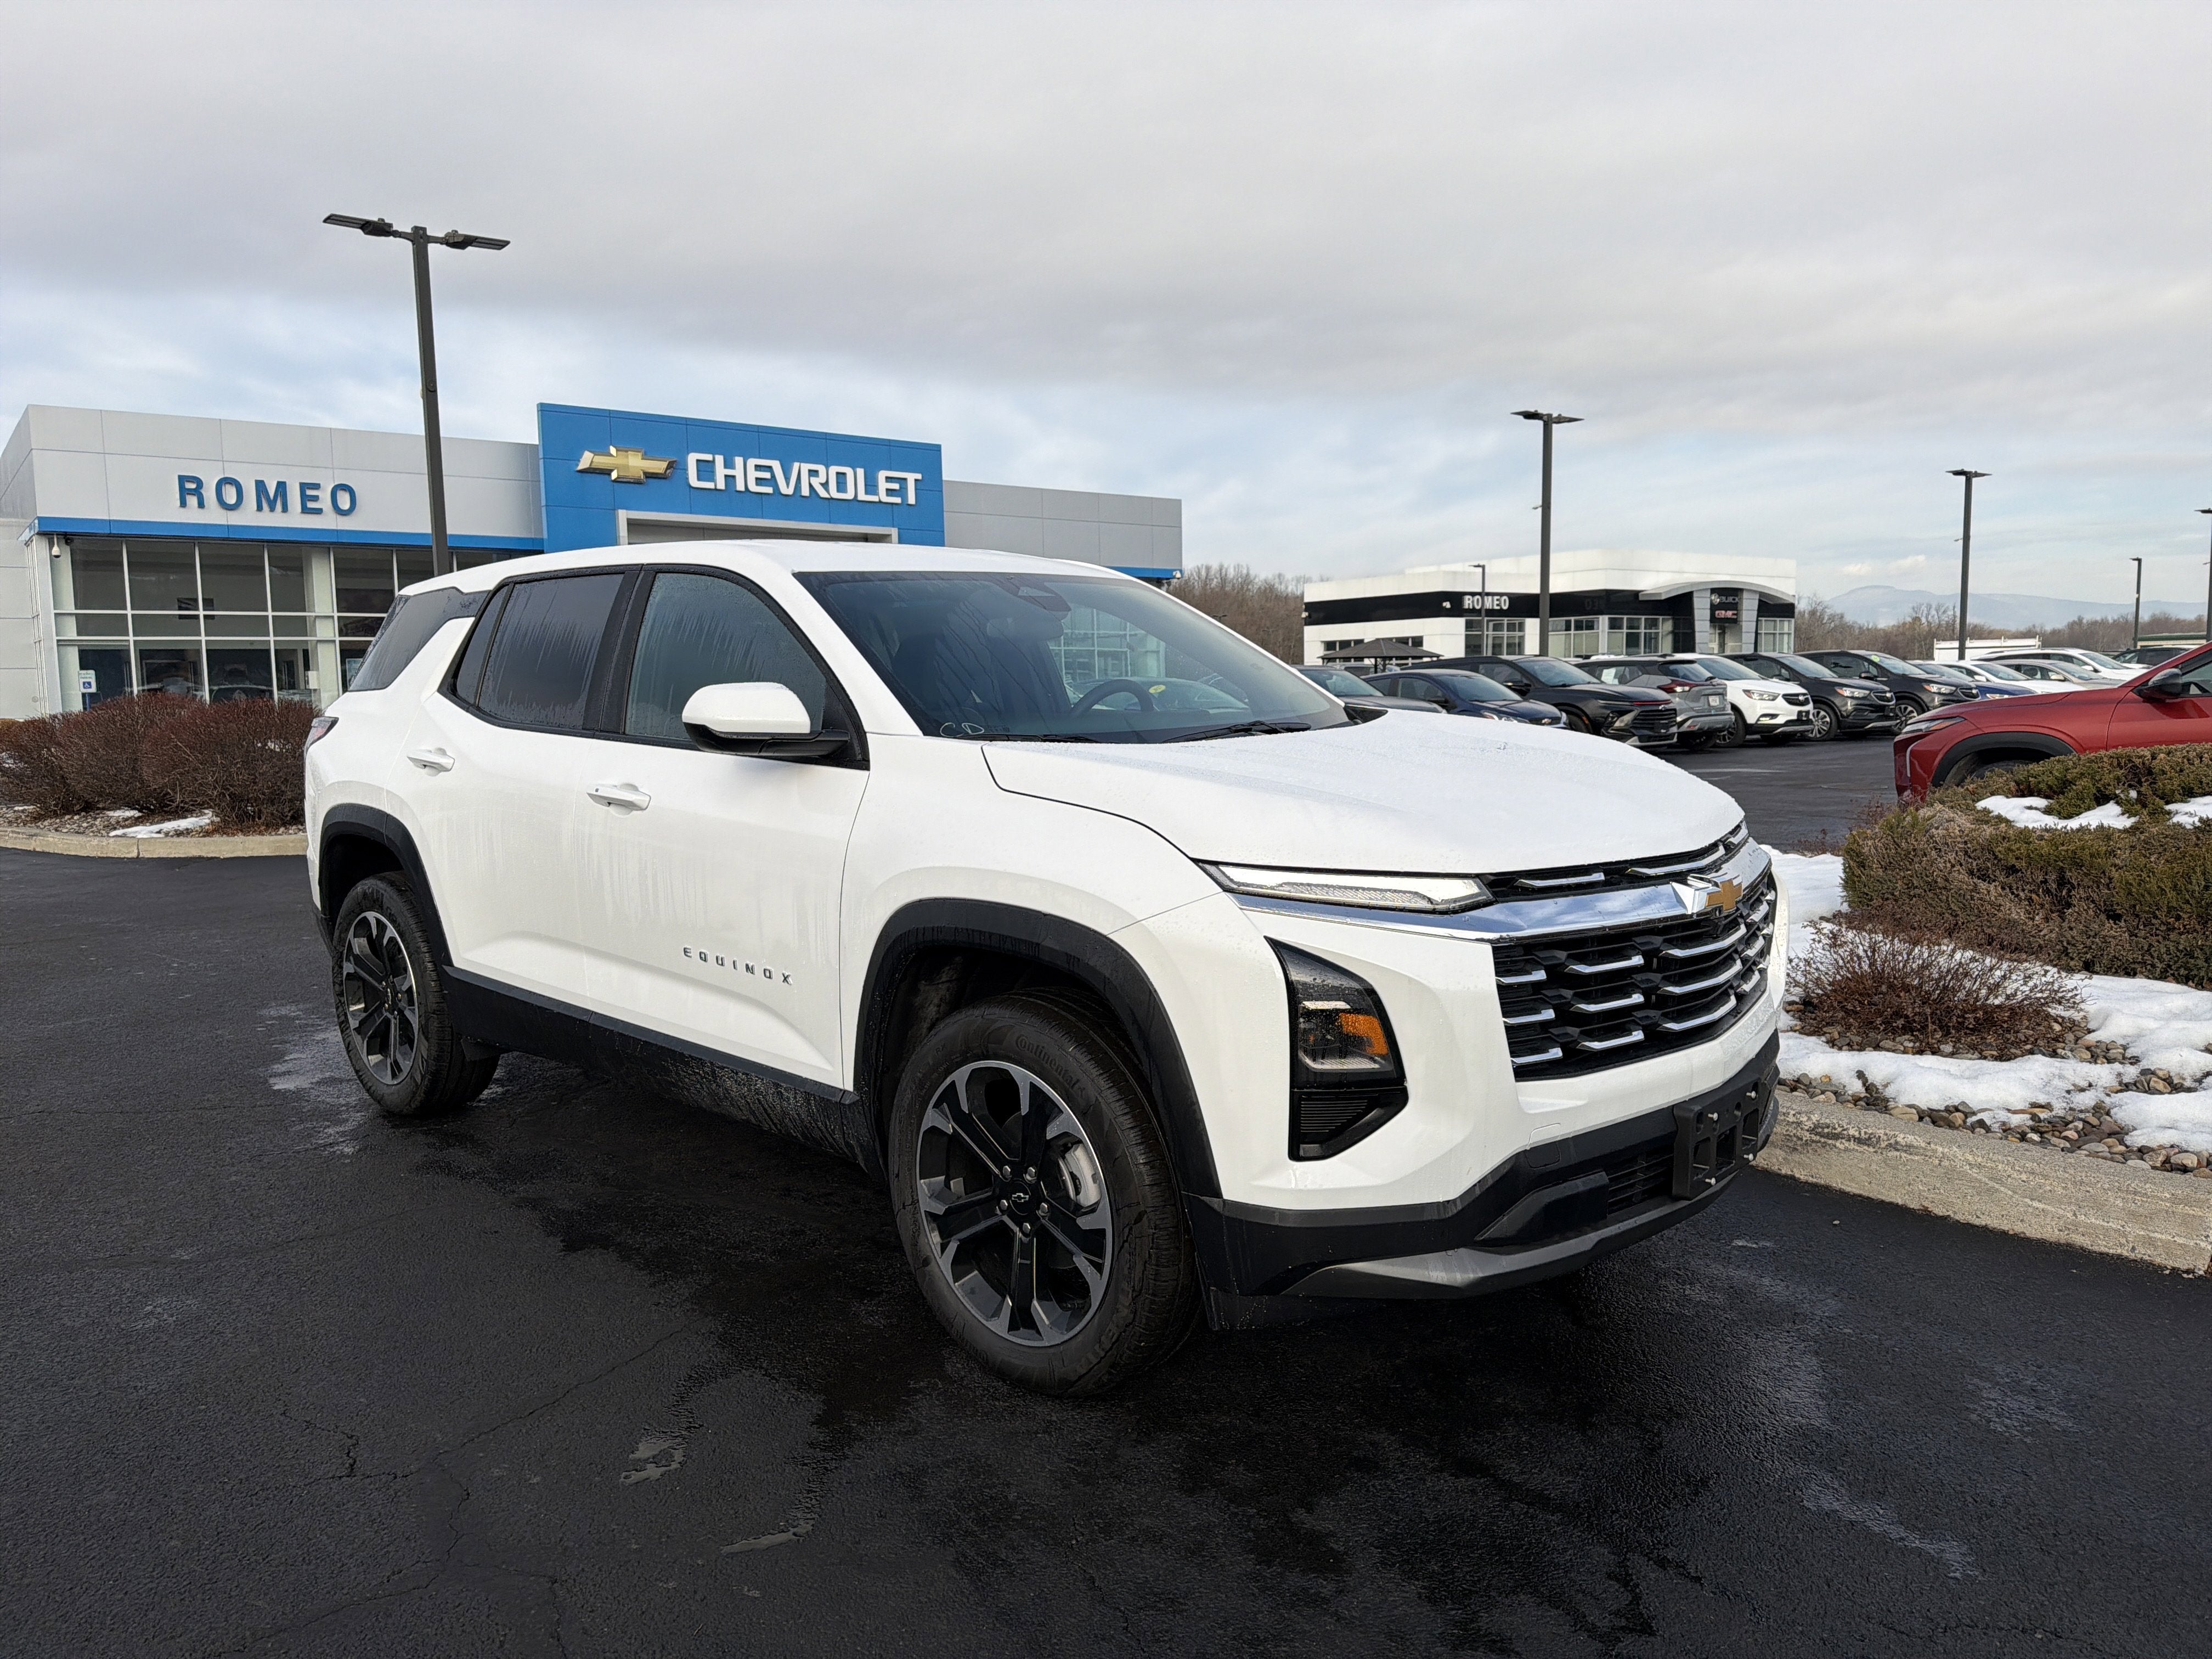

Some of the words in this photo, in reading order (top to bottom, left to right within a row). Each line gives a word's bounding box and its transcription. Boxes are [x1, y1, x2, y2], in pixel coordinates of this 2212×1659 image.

[177, 474, 358, 516] ROMEO
[687, 452, 923, 505] CHEVROLET
[1463, 595, 1509, 610] ROMEO
[682, 945, 793, 985] EQUINOX
[1015, 1033, 1081, 1091] Continental
